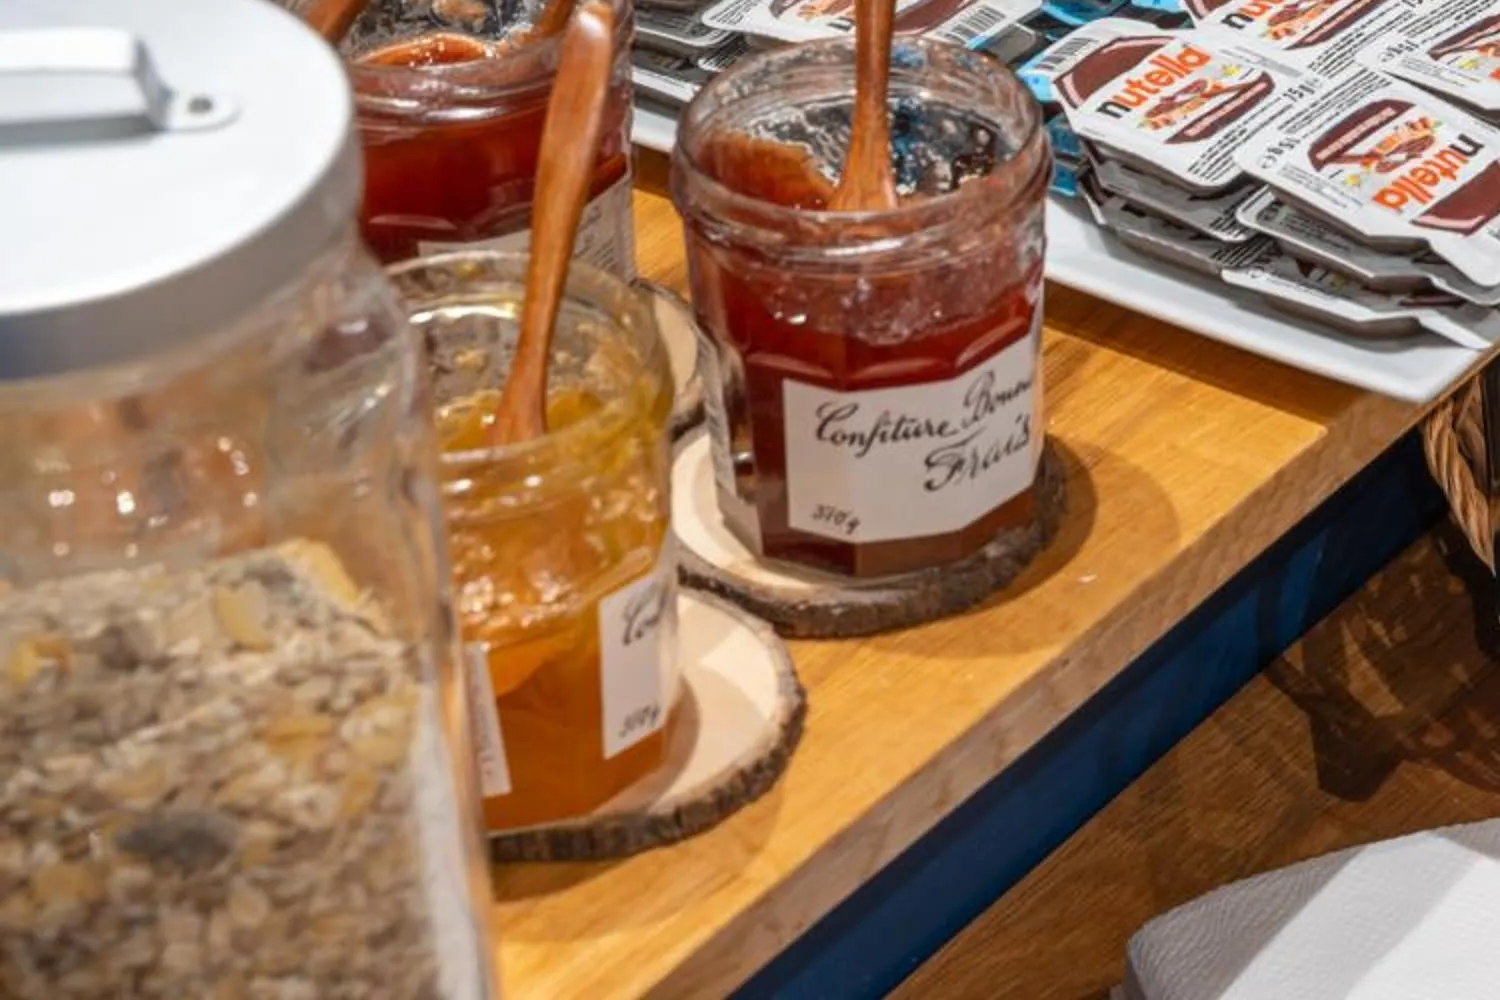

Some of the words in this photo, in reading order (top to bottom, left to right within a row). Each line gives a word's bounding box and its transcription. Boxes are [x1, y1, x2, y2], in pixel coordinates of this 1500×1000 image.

[1096, 46, 1212, 119] nutella
[1372, 133, 1484, 213] nutella
[815, 402, 960, 459] Confiture
